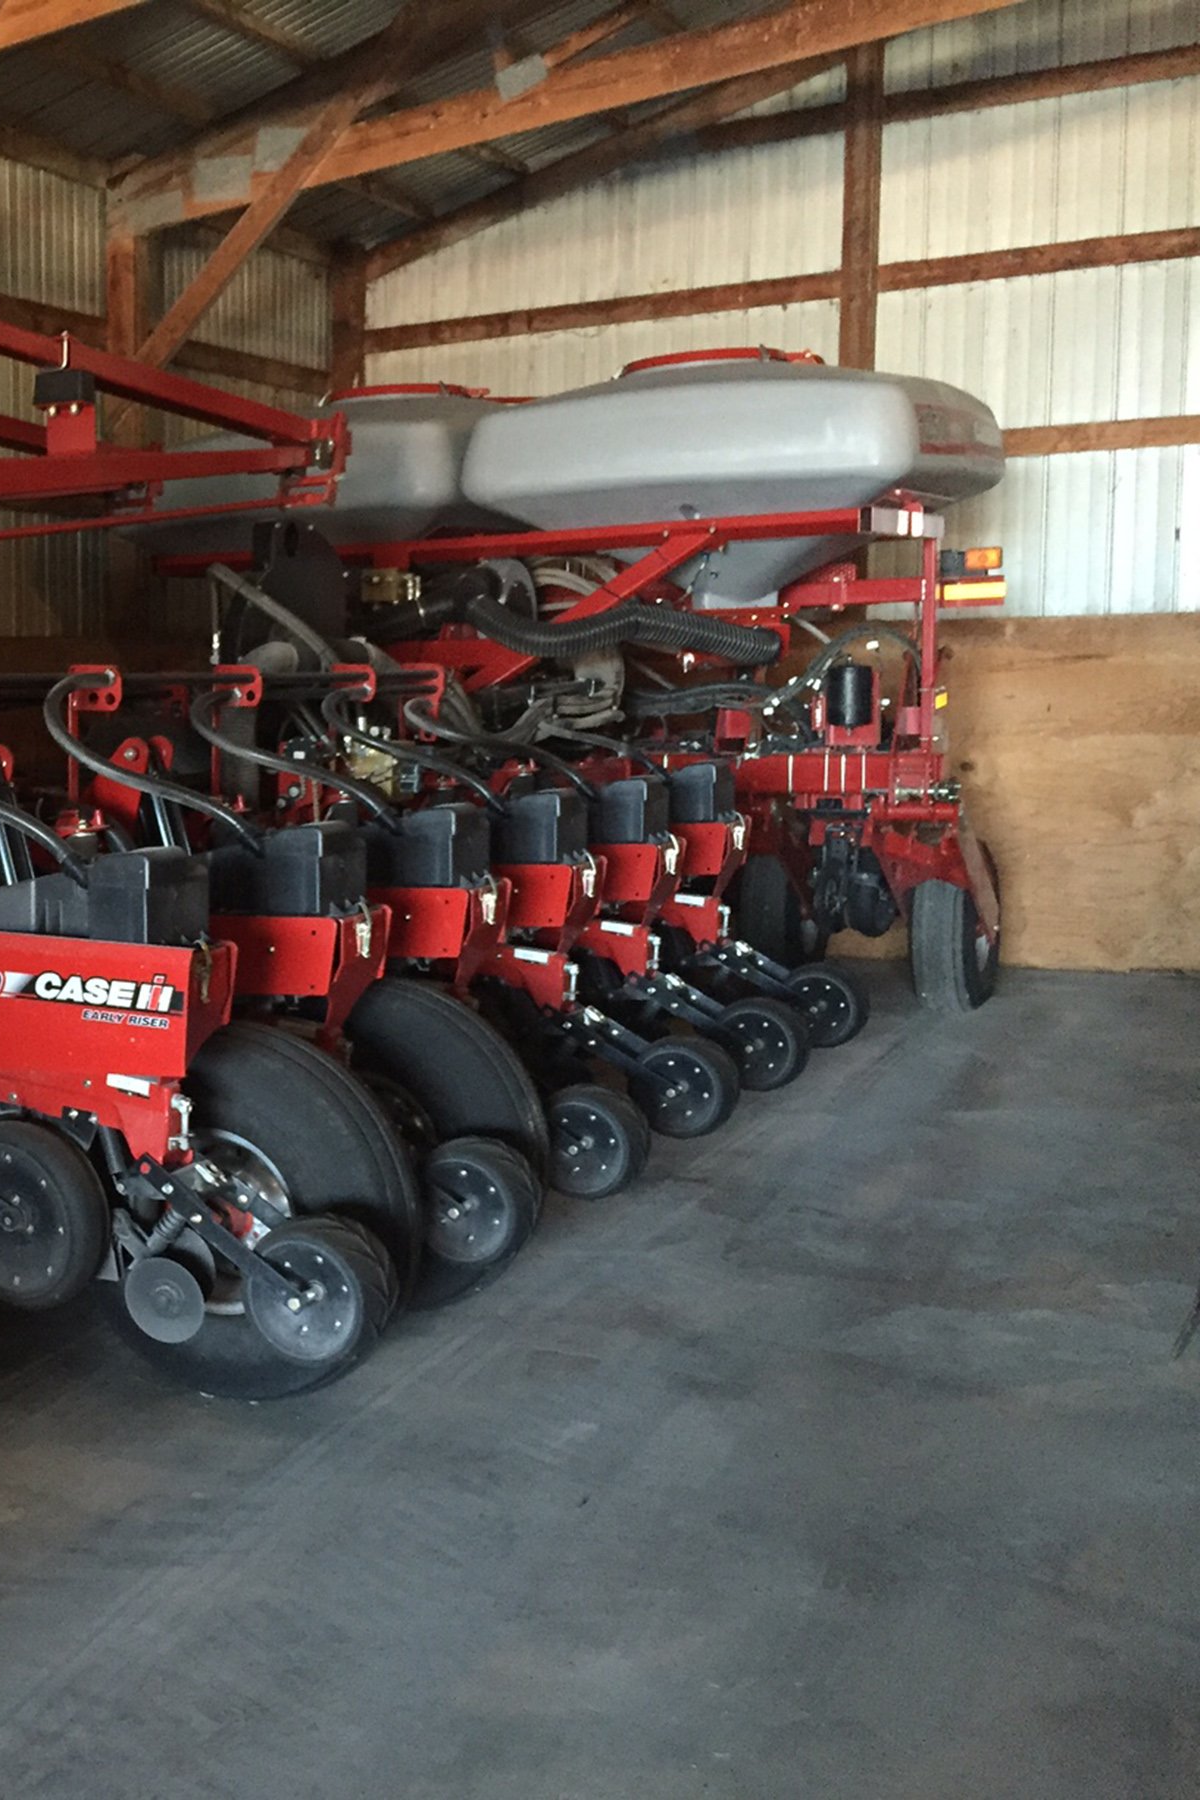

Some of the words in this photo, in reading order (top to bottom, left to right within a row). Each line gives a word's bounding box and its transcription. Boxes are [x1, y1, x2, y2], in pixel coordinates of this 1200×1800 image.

[34, 971, 137, 1009] CASE
[82, 1009, 125, 1025] EARLY
[127, 1014, 169, 1029] RISER
